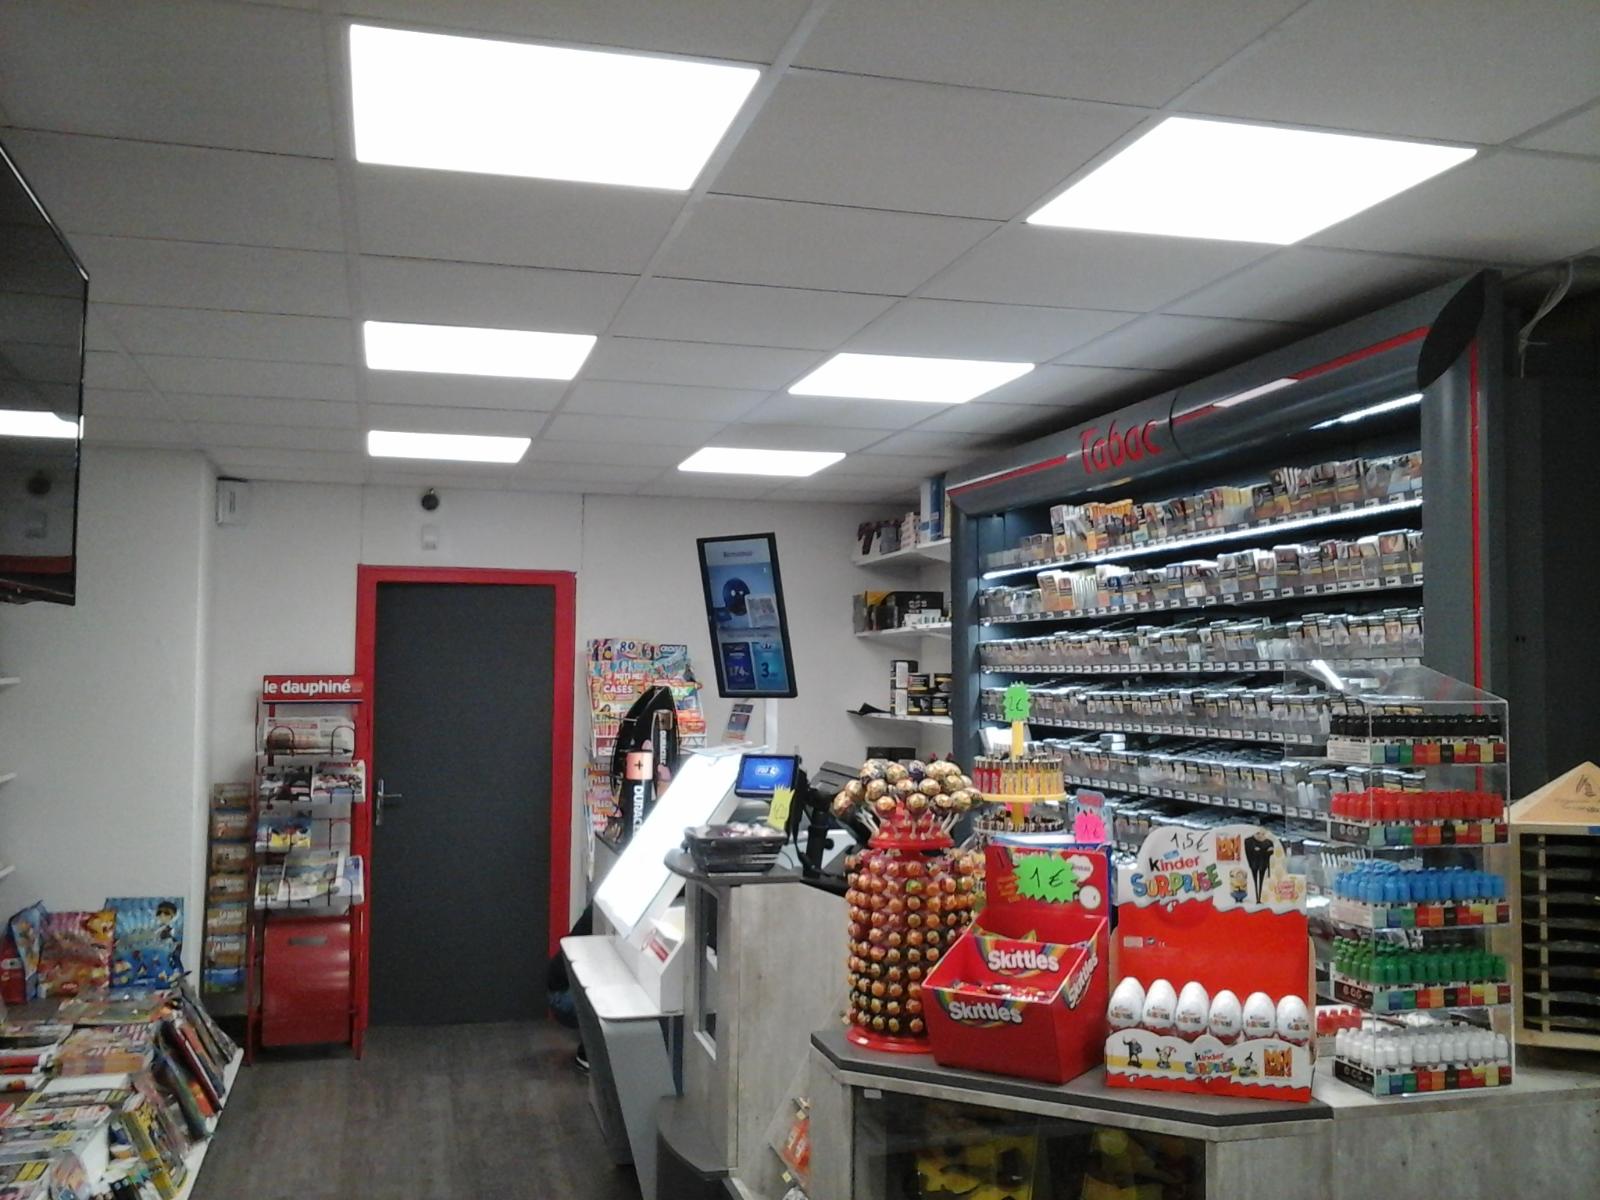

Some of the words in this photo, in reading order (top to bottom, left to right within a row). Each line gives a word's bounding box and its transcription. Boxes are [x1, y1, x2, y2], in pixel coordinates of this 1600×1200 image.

[1079, 418, 1163, 476] Tabac
[263, 680, 278, 694] le
[280, 679, 351, 697] dauphiné
[603, 684, 634, 694] CASES
[1130, 862, 1223, 898] SURPRISE
[987, 948, 1061, 972] Skittles
[949, 1001, 1023, 1024] Skittles
